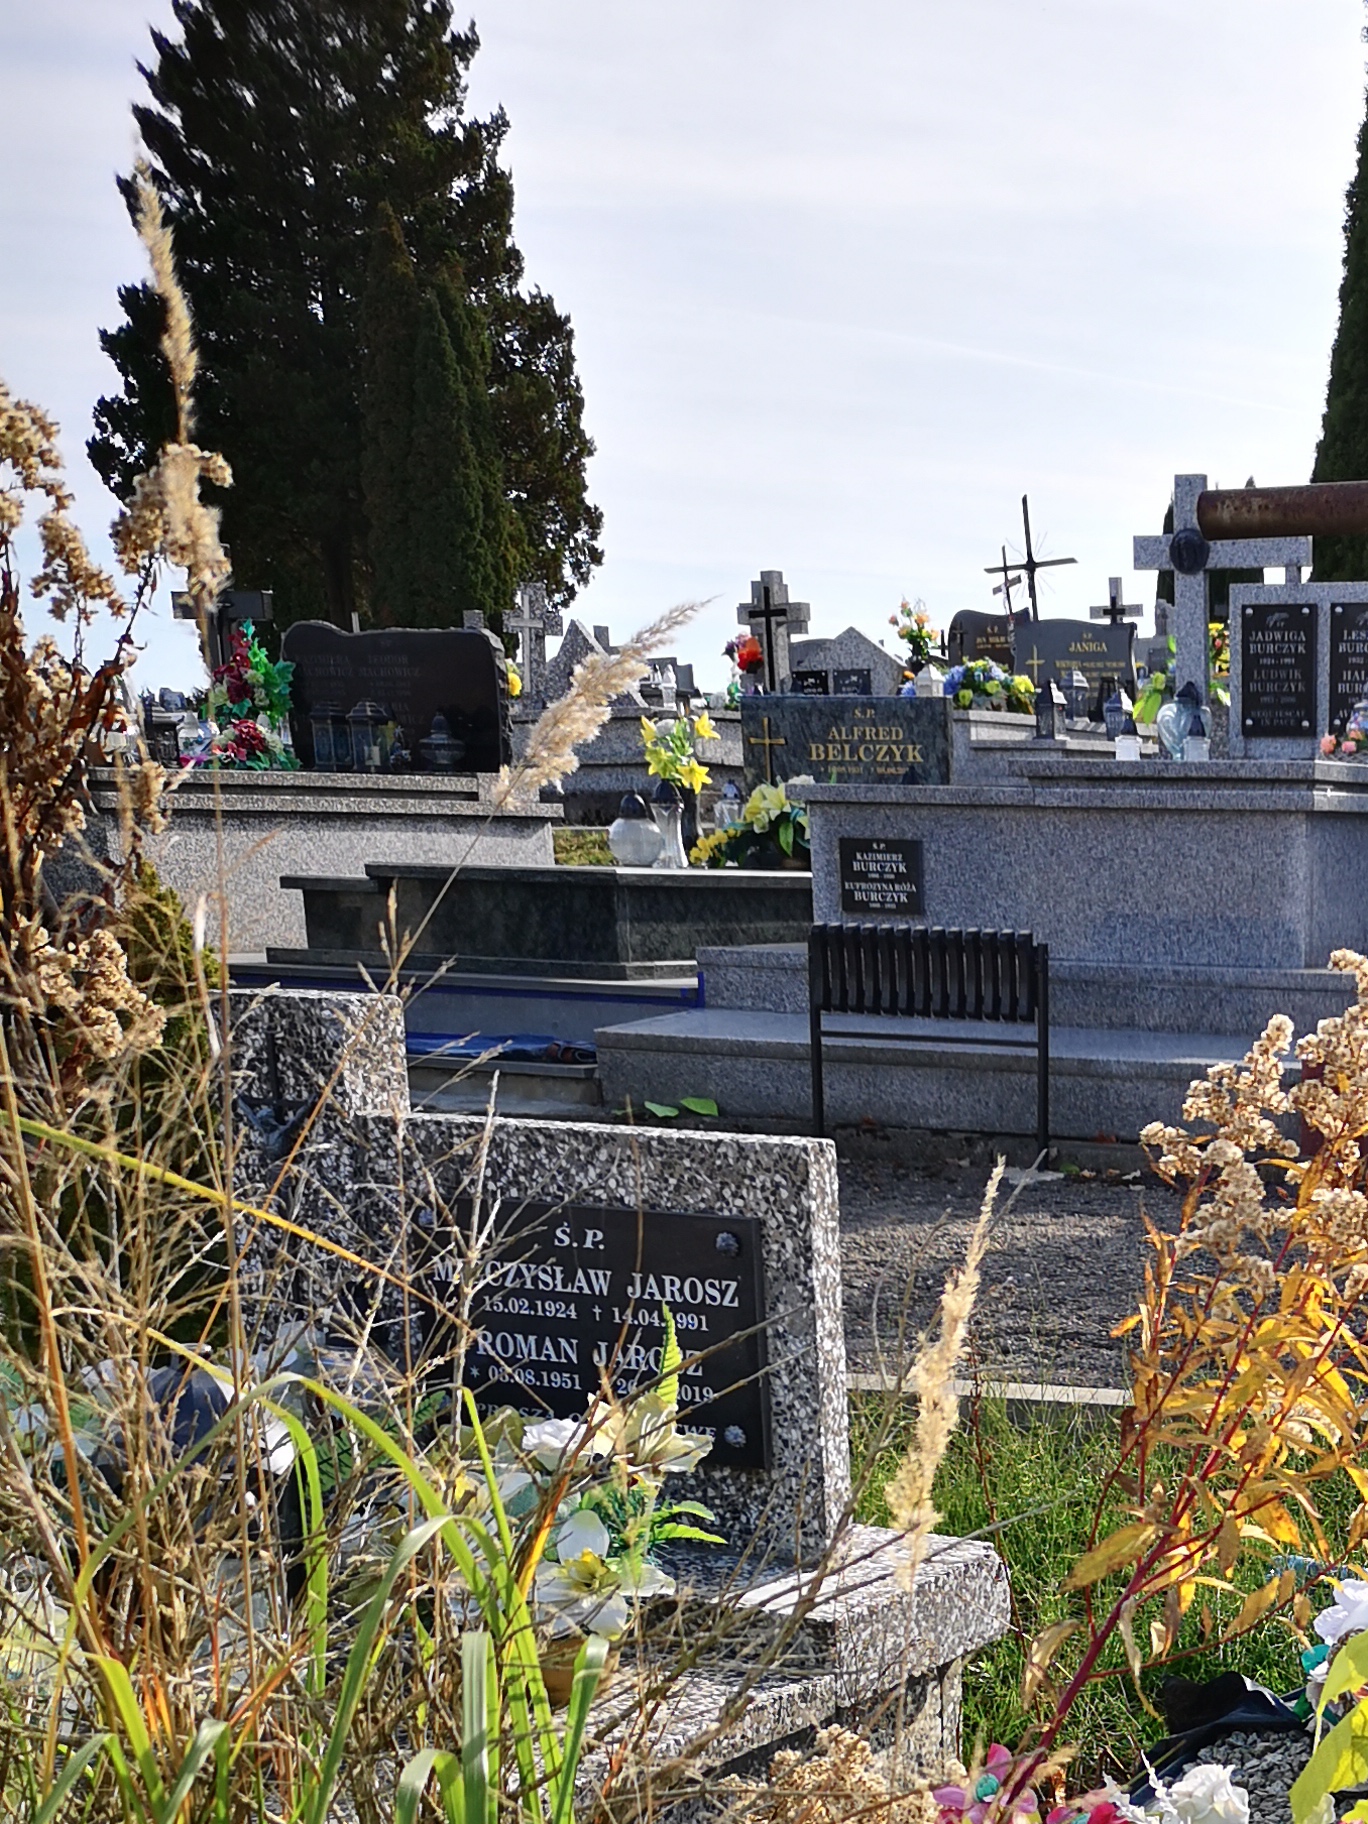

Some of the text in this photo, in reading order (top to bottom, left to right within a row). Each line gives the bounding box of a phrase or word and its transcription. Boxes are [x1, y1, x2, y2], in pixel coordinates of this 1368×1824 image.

[1249, 631, 1306, 642] JADWIGA
[1068, 642, 1107, 653] JANIGA
[1249, 643, 1306, 654] BURCZYK
[1253, 669, 1302, 680] LUDWIK
[1249, 682, 1305, 692] BURCZYK
[828, 727, 903, 740] ALFRED
[809, 743, 924, 762] BELCZYK
[856, 852, 903, 861] KAZIMIERZ
[852, 861, 907, 873] BURCZYK
[854, 891, 908, 903] BURCZYK
[432, 1255, 739, 1308] MCZYSŁAW JAROSZ
[483, 1295, 709, 1331] 15.02.1924 14.04.991
[476, 1330, 703, 1376] ROMAN JAROZ
